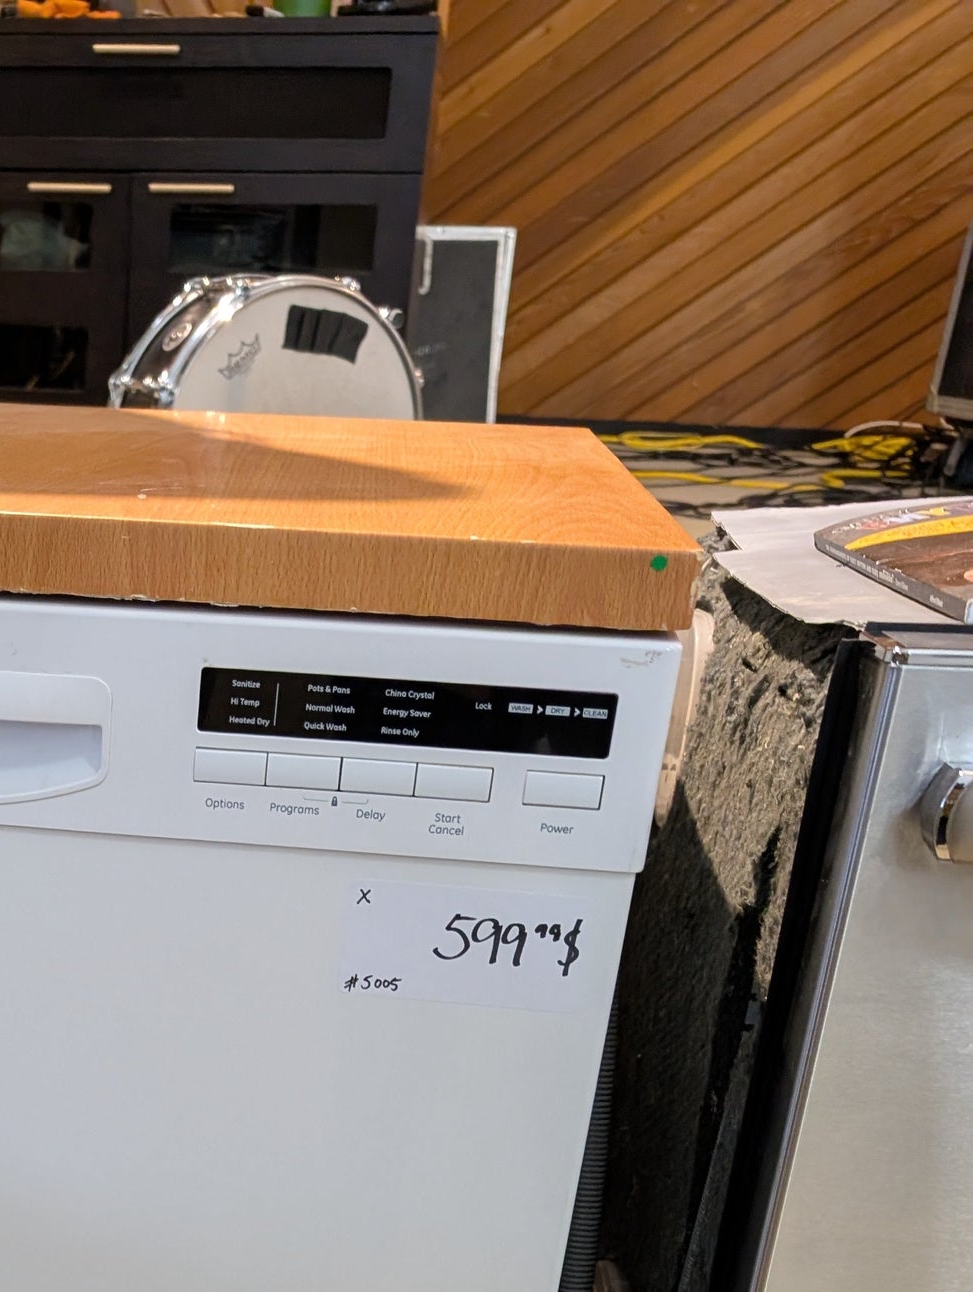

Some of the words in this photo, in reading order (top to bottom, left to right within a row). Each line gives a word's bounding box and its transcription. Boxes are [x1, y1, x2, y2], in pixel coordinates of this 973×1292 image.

[231, 679, 261, 689] Sanitize
[307, 683, 324, 693] Pots
[325, 685, 332, 694] &
[332, 685, 351, 695] Pans
[385, 688, 407, 698] China
[408, 690, 435, 700] Crystal
[230, 697, 239, 706] Hi
[240, 698, 260, 708] Temp
[305, 703, 334, 713] Normal
[334, 705, 355, 714] Wash
[475, 702, 492, 711] Lock
[511, 704, 531, 712] WASH
[382, 707, 409, 718] Energy
[409, 709, 431, 719] Saver
[550, 706, 565, 715] DRY
[583, 709, 607, 718] CLEAN
[229, 715, 255, 725] Heated
[256, 717, 270, 728] Dry
[304, 721, 325, 731] Quick
[325, 722, 347, 732] Wash
[380, 726, 401, 736] Rinse
[402, 727, 419, 738] Only
[205, 797, 245, 810] Options
[269, 802, 320, 816] Programs
[355, 808, 386, 822] Delay
[434, 812, 461, 824] Start
[428, 824, 465, 836] Cancel
[540, 822, 574, 835] Power
[343, 973, 402, 992] #5005
